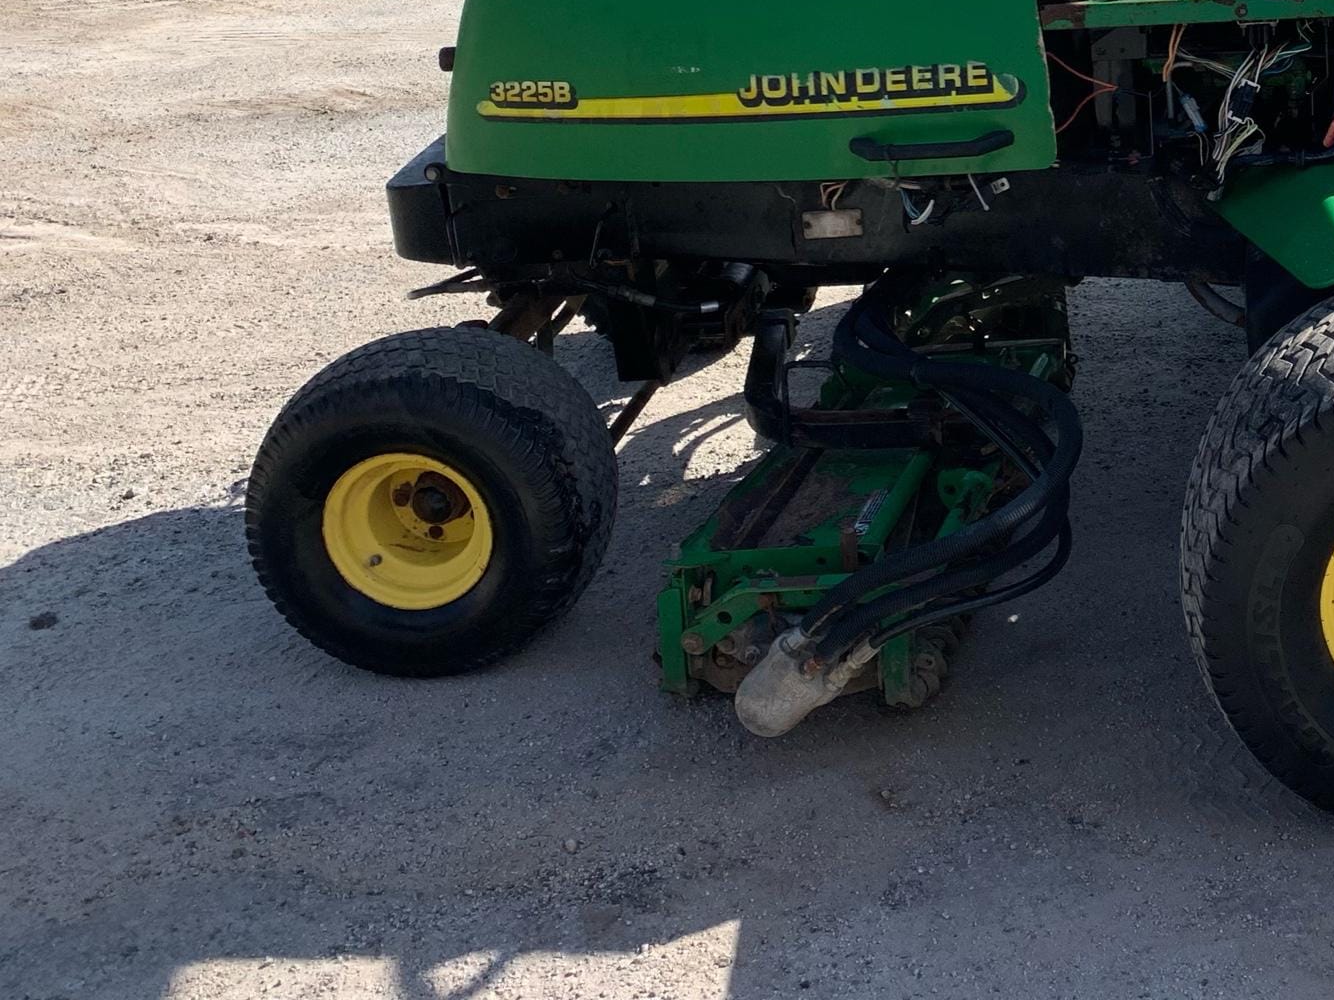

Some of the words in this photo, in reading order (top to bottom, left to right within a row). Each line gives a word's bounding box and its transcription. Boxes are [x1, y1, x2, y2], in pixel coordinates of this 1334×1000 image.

[489, 80, 573, 104] 3225B
[739, 70, 848, 103] JOHN
[856, 60, 991, 95] DEERE
